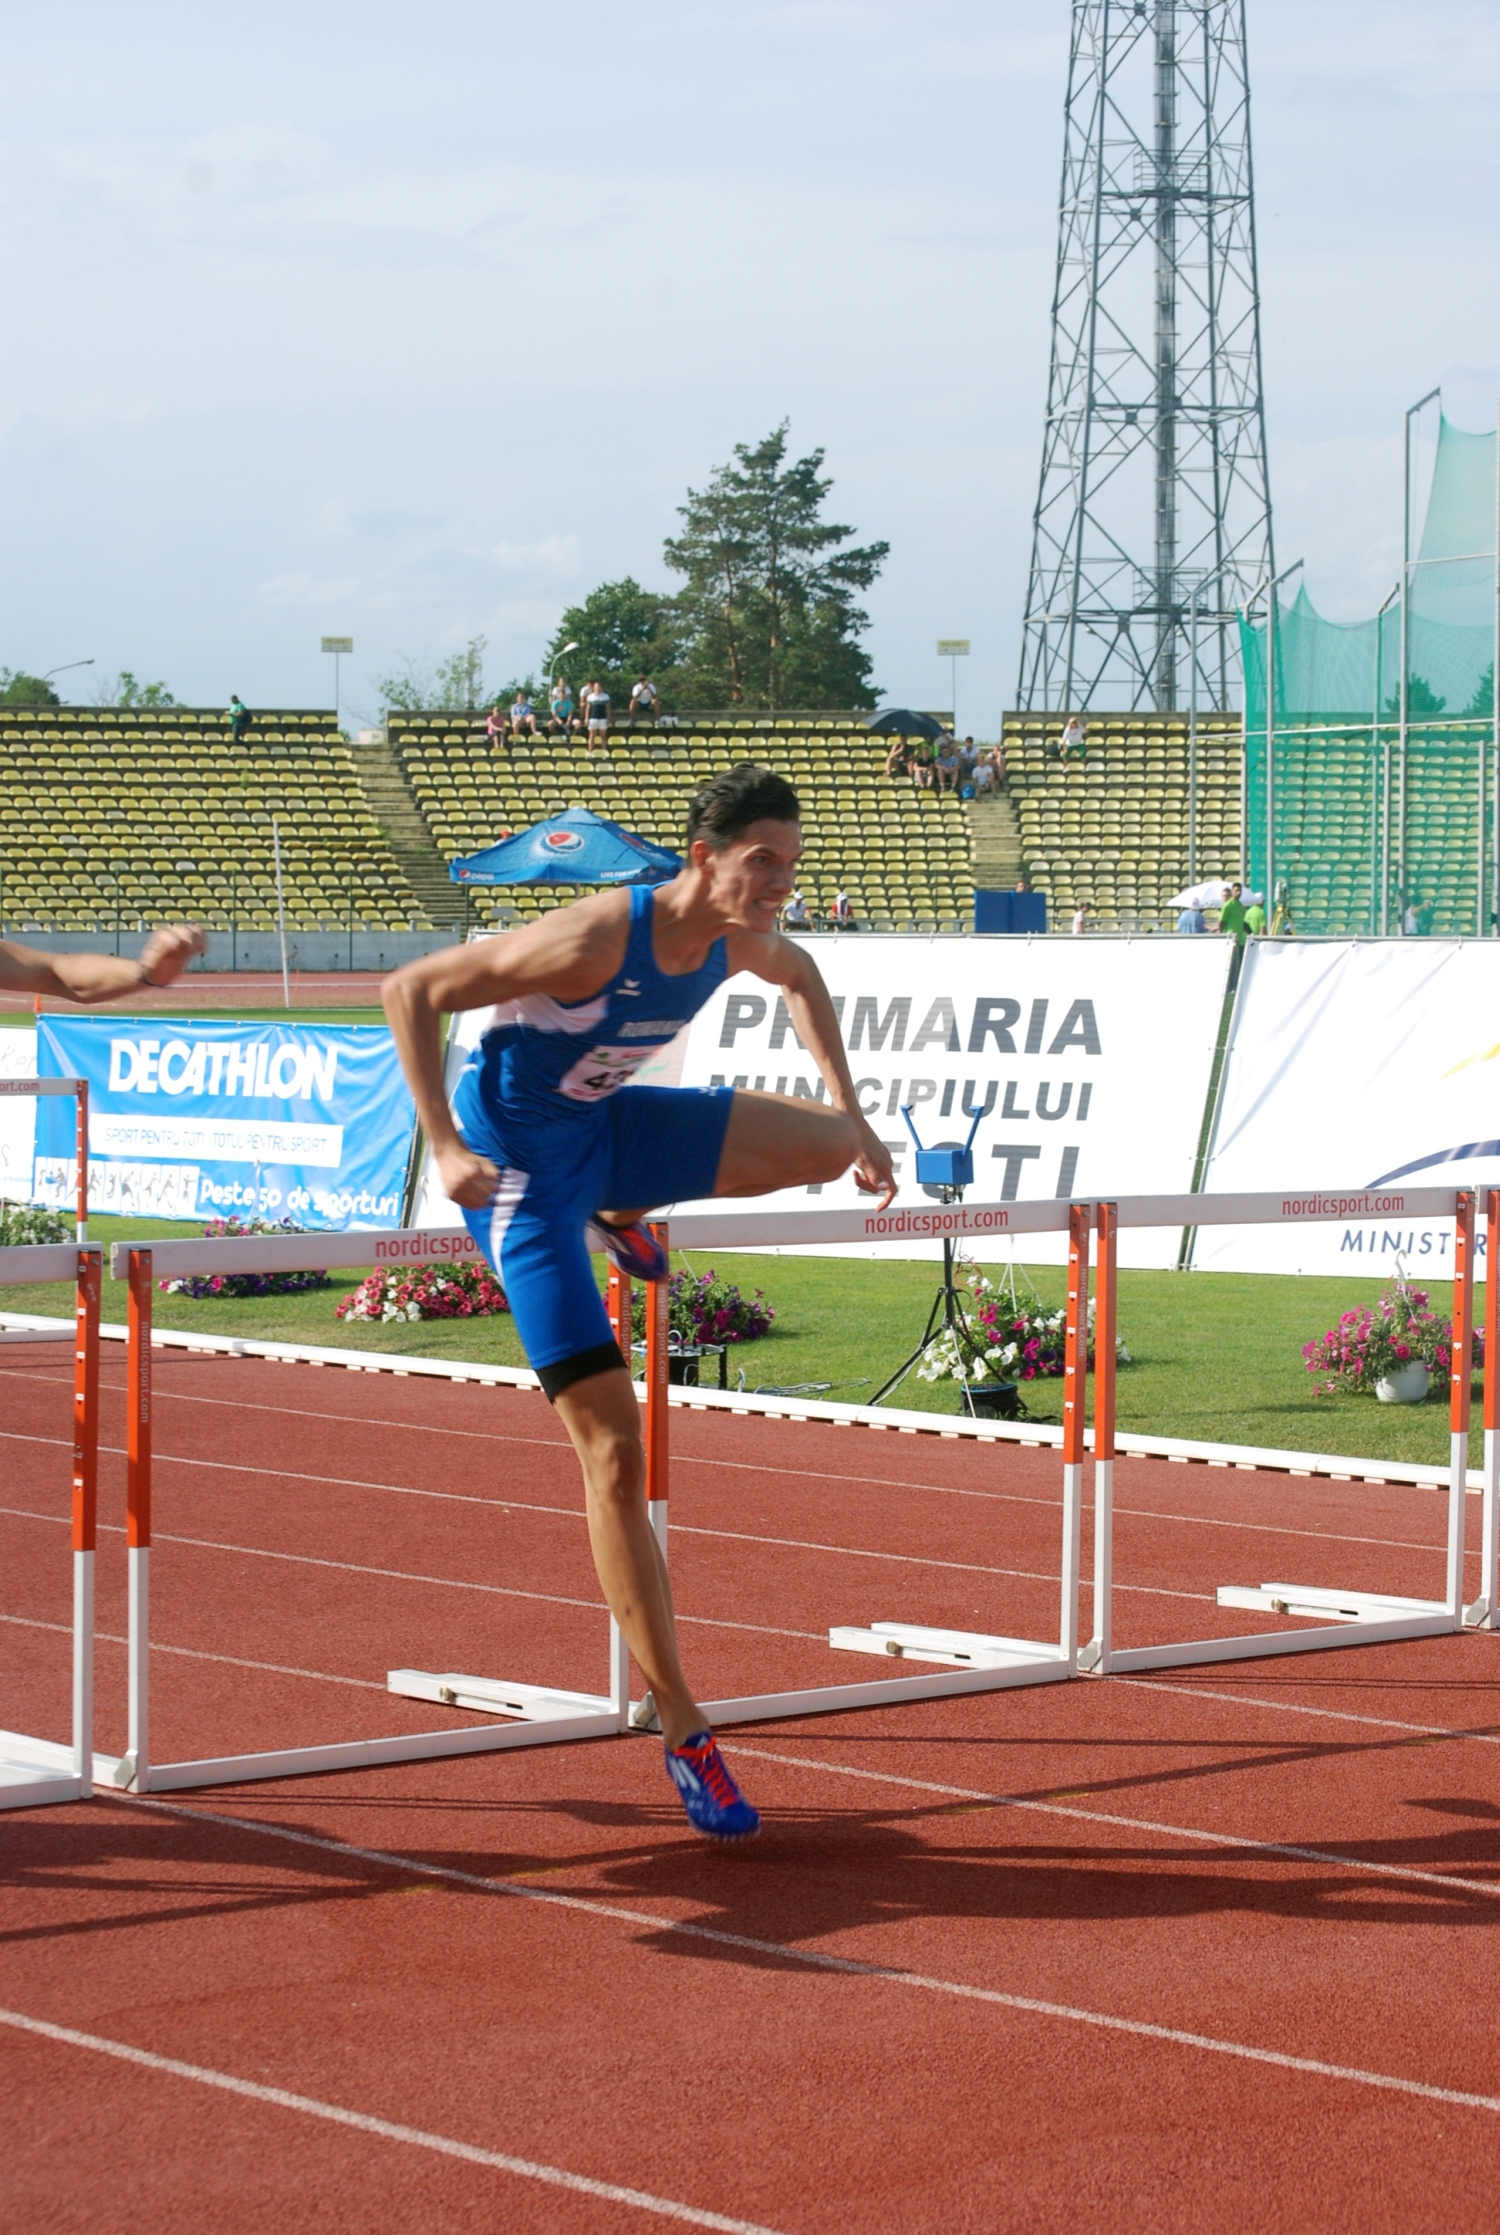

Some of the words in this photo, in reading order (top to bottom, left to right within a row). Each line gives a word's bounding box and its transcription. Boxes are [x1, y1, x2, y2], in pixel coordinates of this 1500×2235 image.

[471, 873, 494, 881] pepsi
[109, 1039, 338, 1101] DECATHLON
[709, 1074, 1093, 1122] NCIPIULUI
[105, 1127, 139, 1143] SPORT
[140, 1129, 180, 1146] PENTRU
[289, 1136, 327, 1153] SPORT
[200, 1179, 256, 1207] Peste
[258, 1186, 283, 1213] 50
[286, 1185, 310, 1211] de
[313, 1189, 399, 1219] sporturi
[1282, 1194, 1405, 1218] nordicsport.com
[864, 1209, 1009, 1236] nordicsport.com
[1340, 1229, 1487, 1256] MINISTR
[1078, 1267, 1088, 1357] nordicsport.com
[657, 1289, 668, 1384] nordicsport.com
[140, 1321, 150, 1423] nordicsport.com
